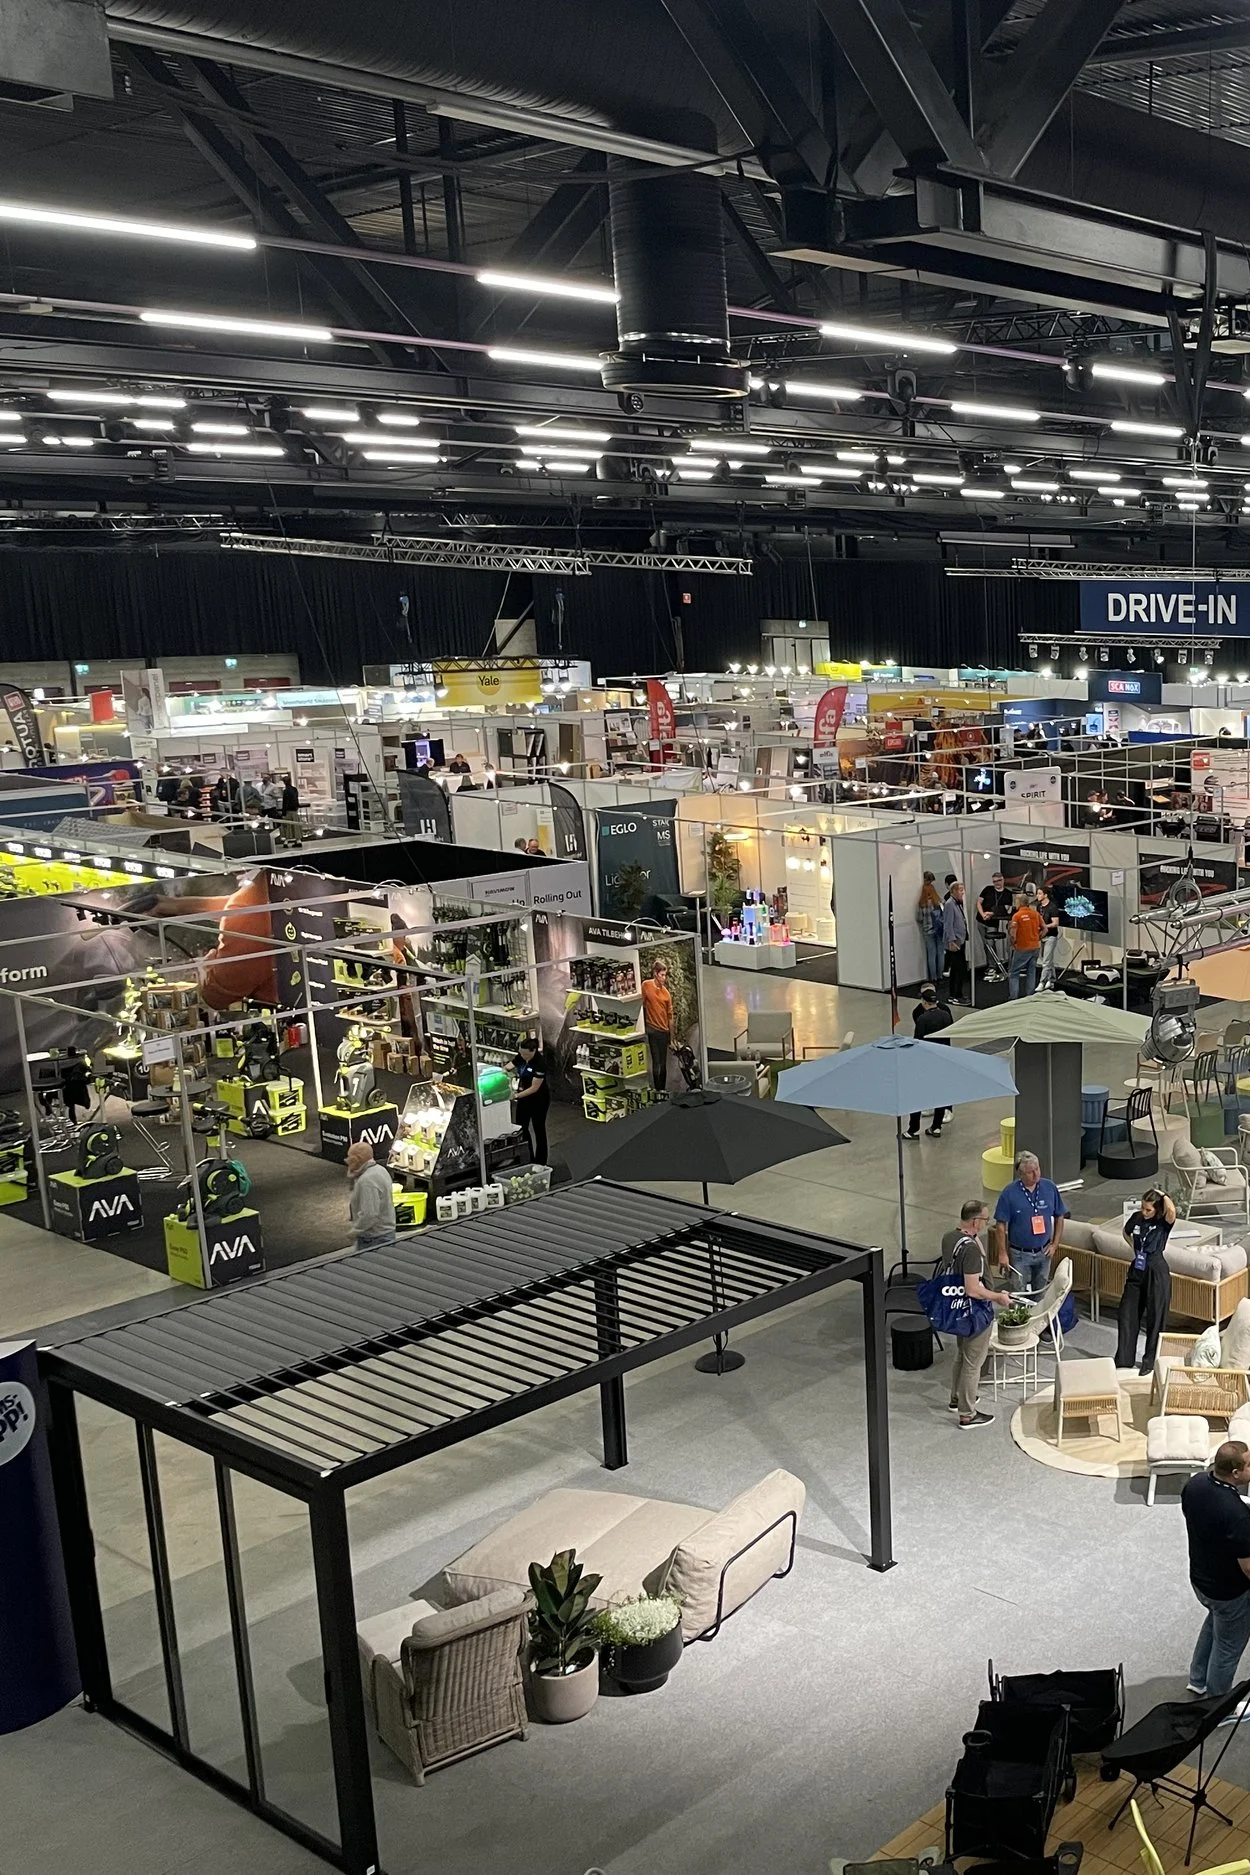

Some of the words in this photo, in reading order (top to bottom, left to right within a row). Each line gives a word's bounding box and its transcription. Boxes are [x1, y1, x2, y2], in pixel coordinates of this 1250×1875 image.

[1107, 592, 1237, 625] DRIVE-IN
[478, 675, 500, 686] Yale
[1021, 790, 1046, 799] SPIRIT
[610, 822, 637, 835] EGLO
[533, 892, 564, 905] Rolling
[566, 890, 582, 900] Out
[588, 927, 601, 936] AVA
[360, 1124, 394, 1145] AVA
[447, 1145, 465, 1158] AVA
[88, 1193, 135, 1223] AVA
[209, 1234, 257, 1266] AVA
[941, 1285, 966, 1297] coo
